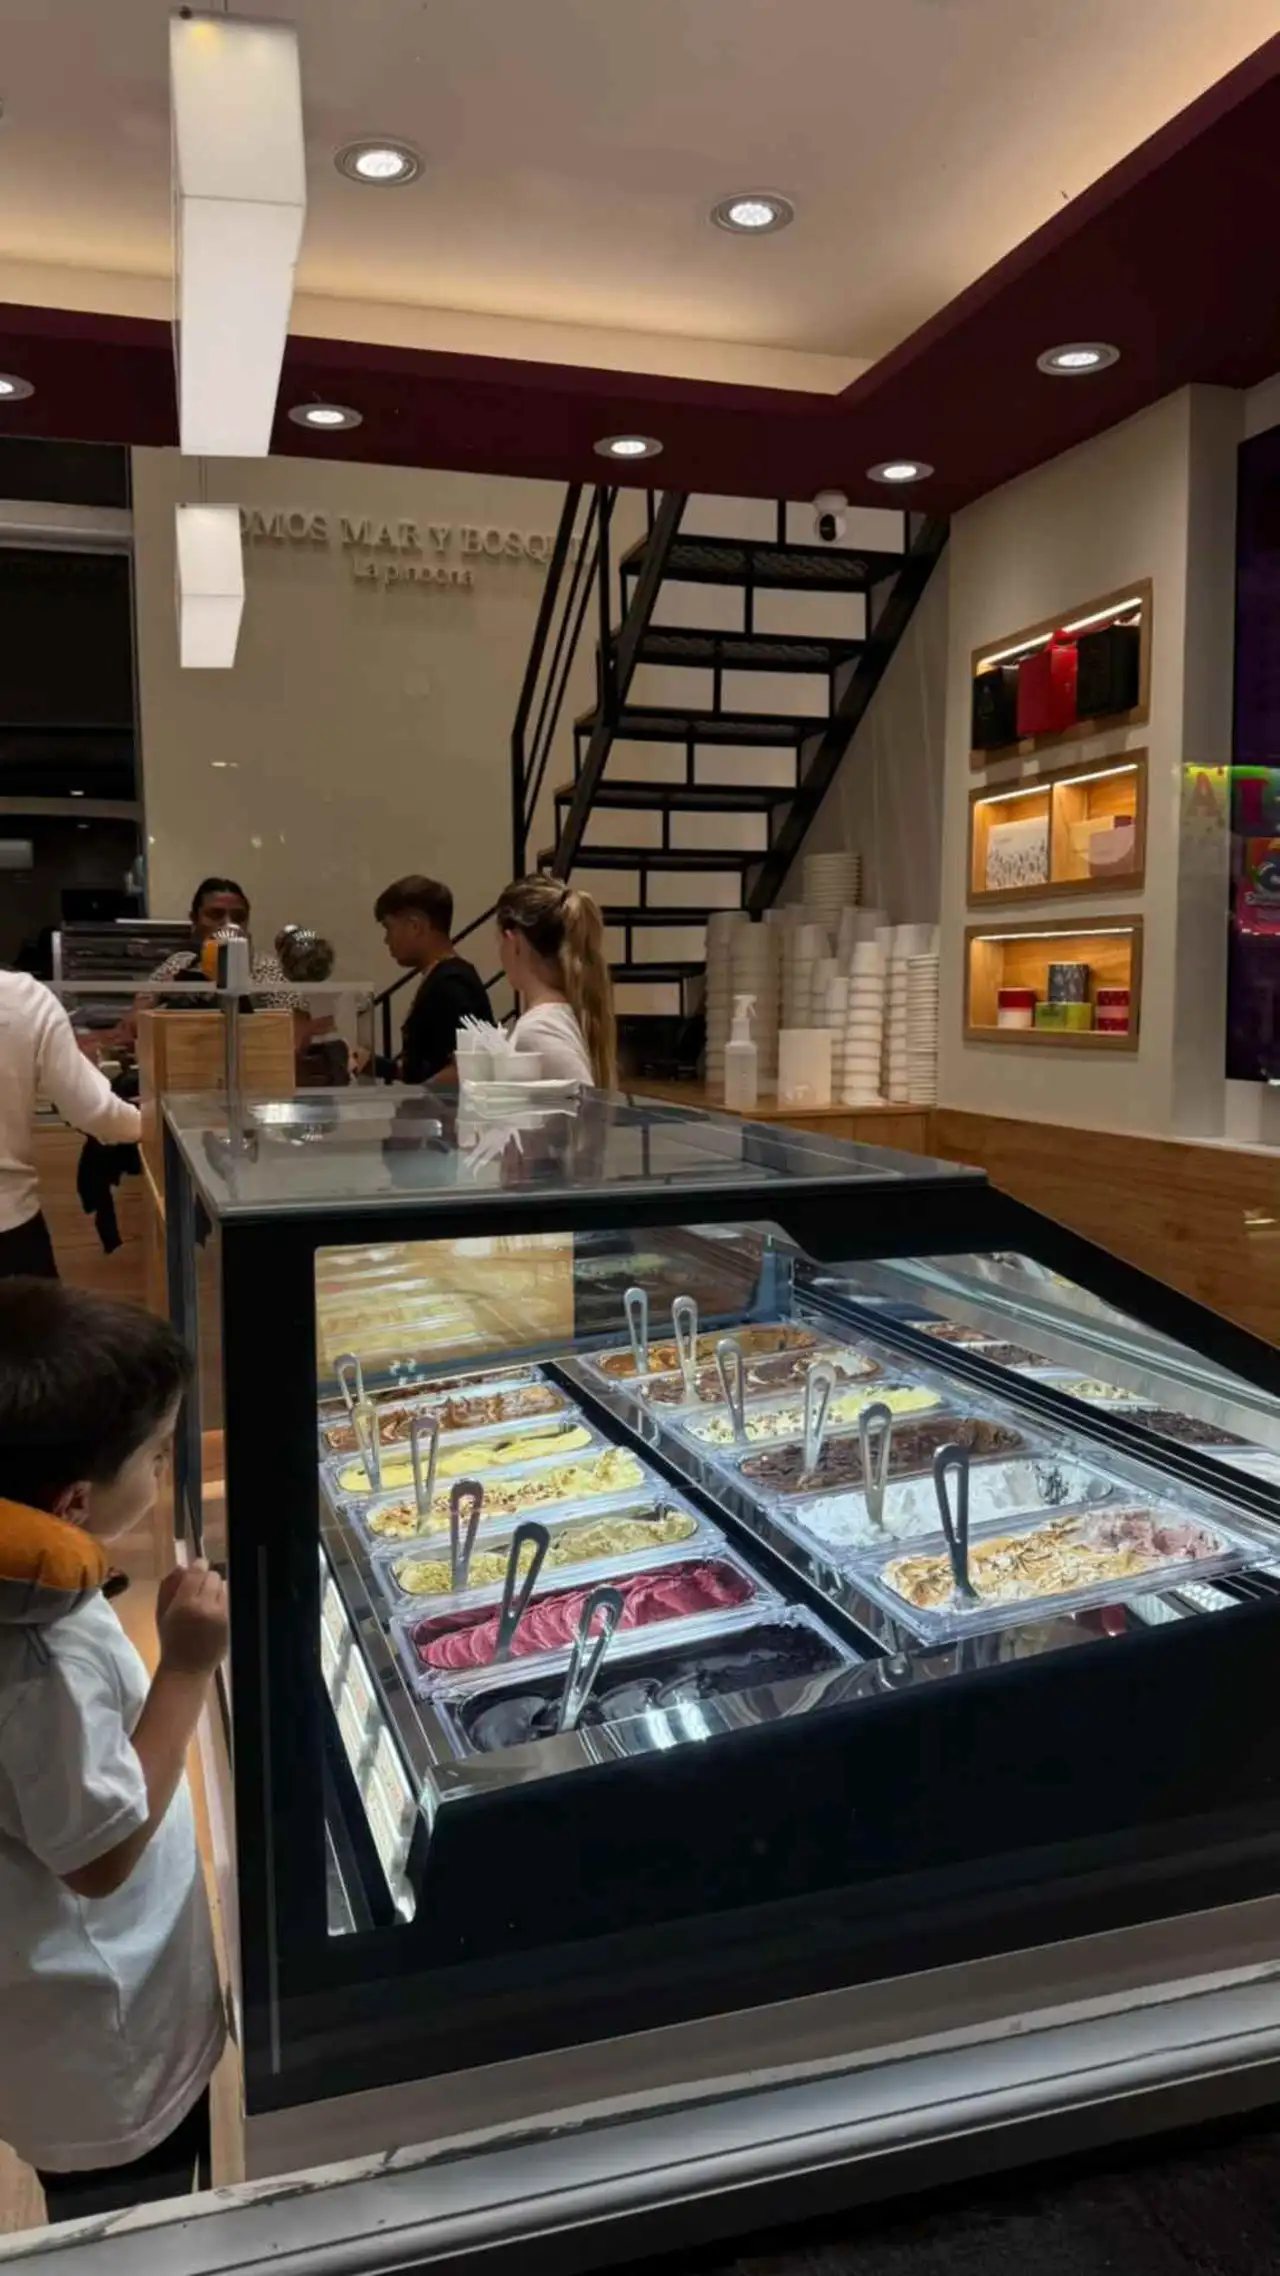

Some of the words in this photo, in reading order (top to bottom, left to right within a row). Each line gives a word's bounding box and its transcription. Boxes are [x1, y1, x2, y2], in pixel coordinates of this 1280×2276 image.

[338, 515, 423, 548] MAR
[427, 521, 452, 551] Y
[353, 556, 378, 577] La
